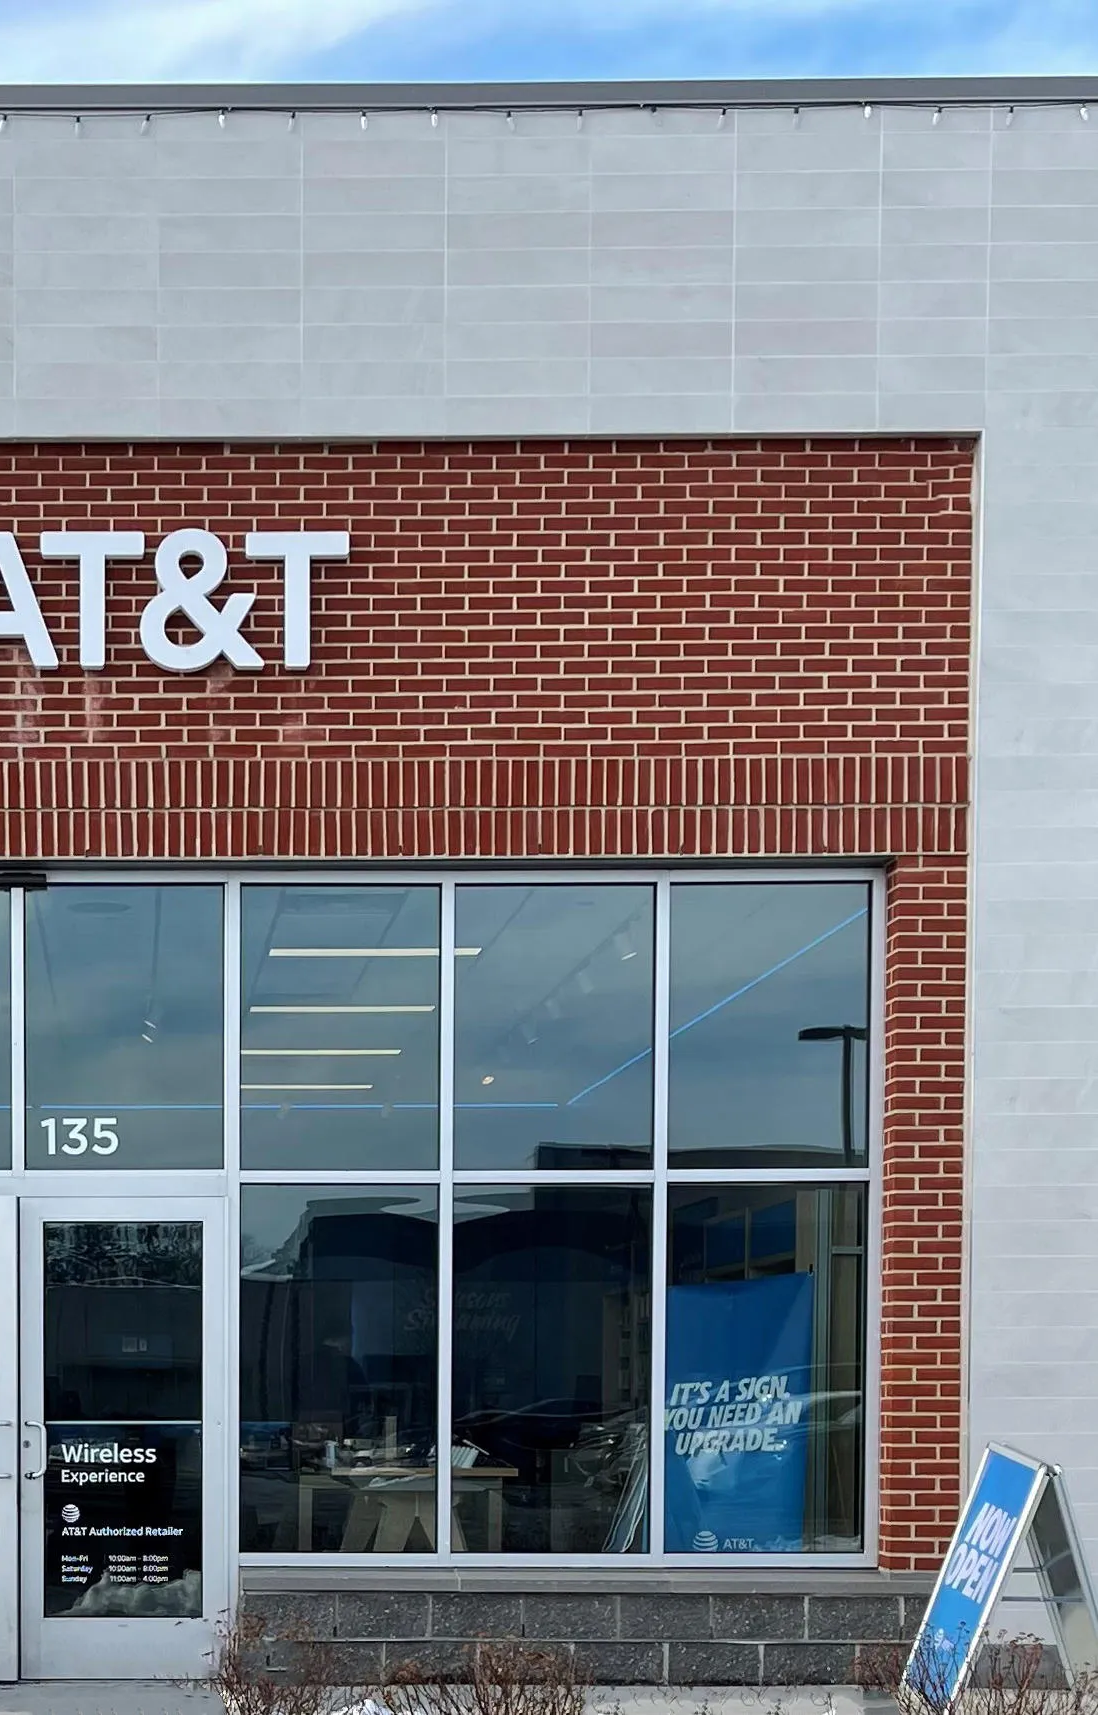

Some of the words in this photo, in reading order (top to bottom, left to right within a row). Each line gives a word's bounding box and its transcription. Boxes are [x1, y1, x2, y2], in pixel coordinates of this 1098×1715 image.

[40, 1117, 119, 1155] 135
[669, 1381, 713, 1406] IT'S
[714, 1379, 730, 1403] A
[663, 1407, 705, 1432] YOU
[707, 1402, 762, 1429] NEED
[766, 1400, 803, 1425] AN
[61, 1442, 157, 1464] Wireless
[61, 1468, 145, 1486] Experience
[61, 1526, 88, 1537] AT&T
[88, 1526, 144, 1537] Authorized
[145, 1526, 183, 1537] Retailer
[964, 1502, 1018, 1558] NOW
[722, 1538, 755, 1550] AT&T
[61, 1565, 93, 1574] Saturday
[61, 1575, 88, 1584] Sunday
[945, 1543, 999, 1605] OPEN
